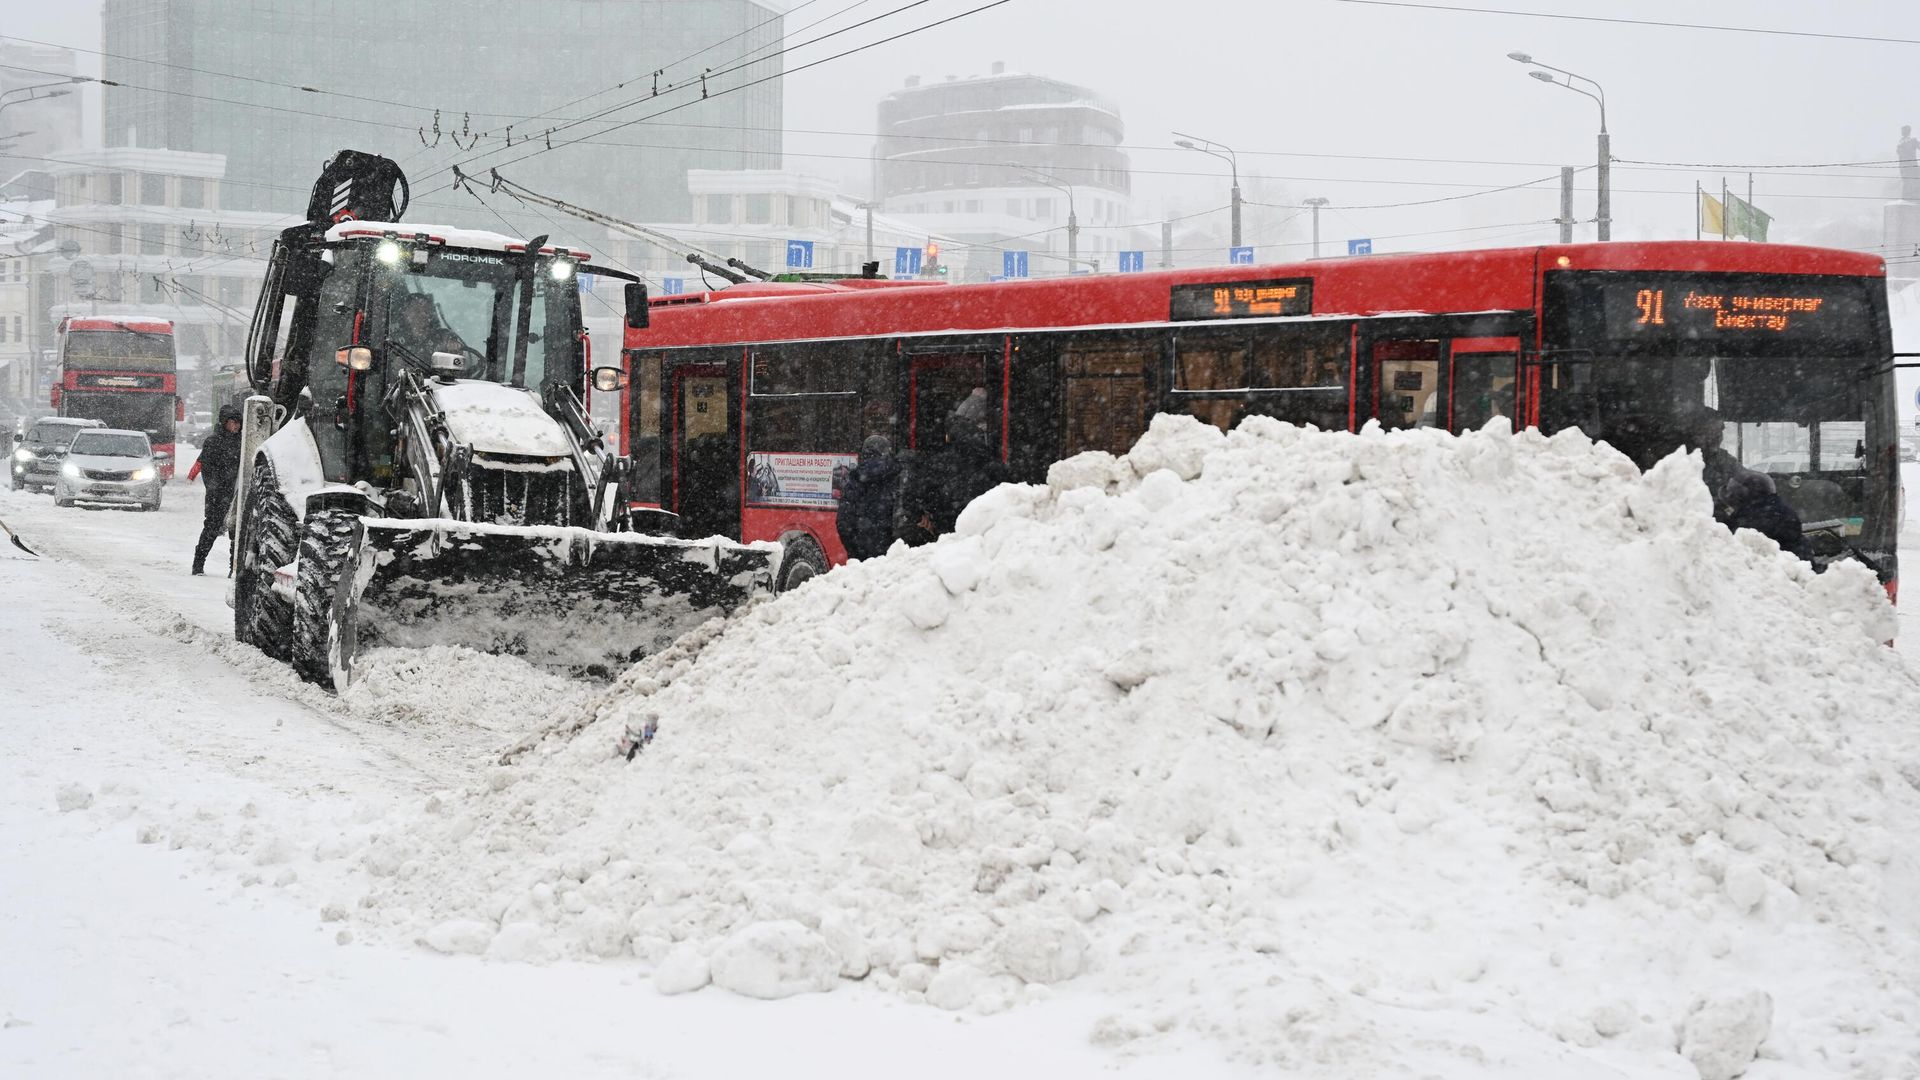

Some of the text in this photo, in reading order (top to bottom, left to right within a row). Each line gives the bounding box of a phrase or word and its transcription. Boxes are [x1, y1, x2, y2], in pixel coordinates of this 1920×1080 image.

[1213, 288, 1232, 313] 91
[1636, 289, 1664, 324] 91
[774, 457, 832, 468] ПРИГЛАШАЕМ НА РАБОТУ
